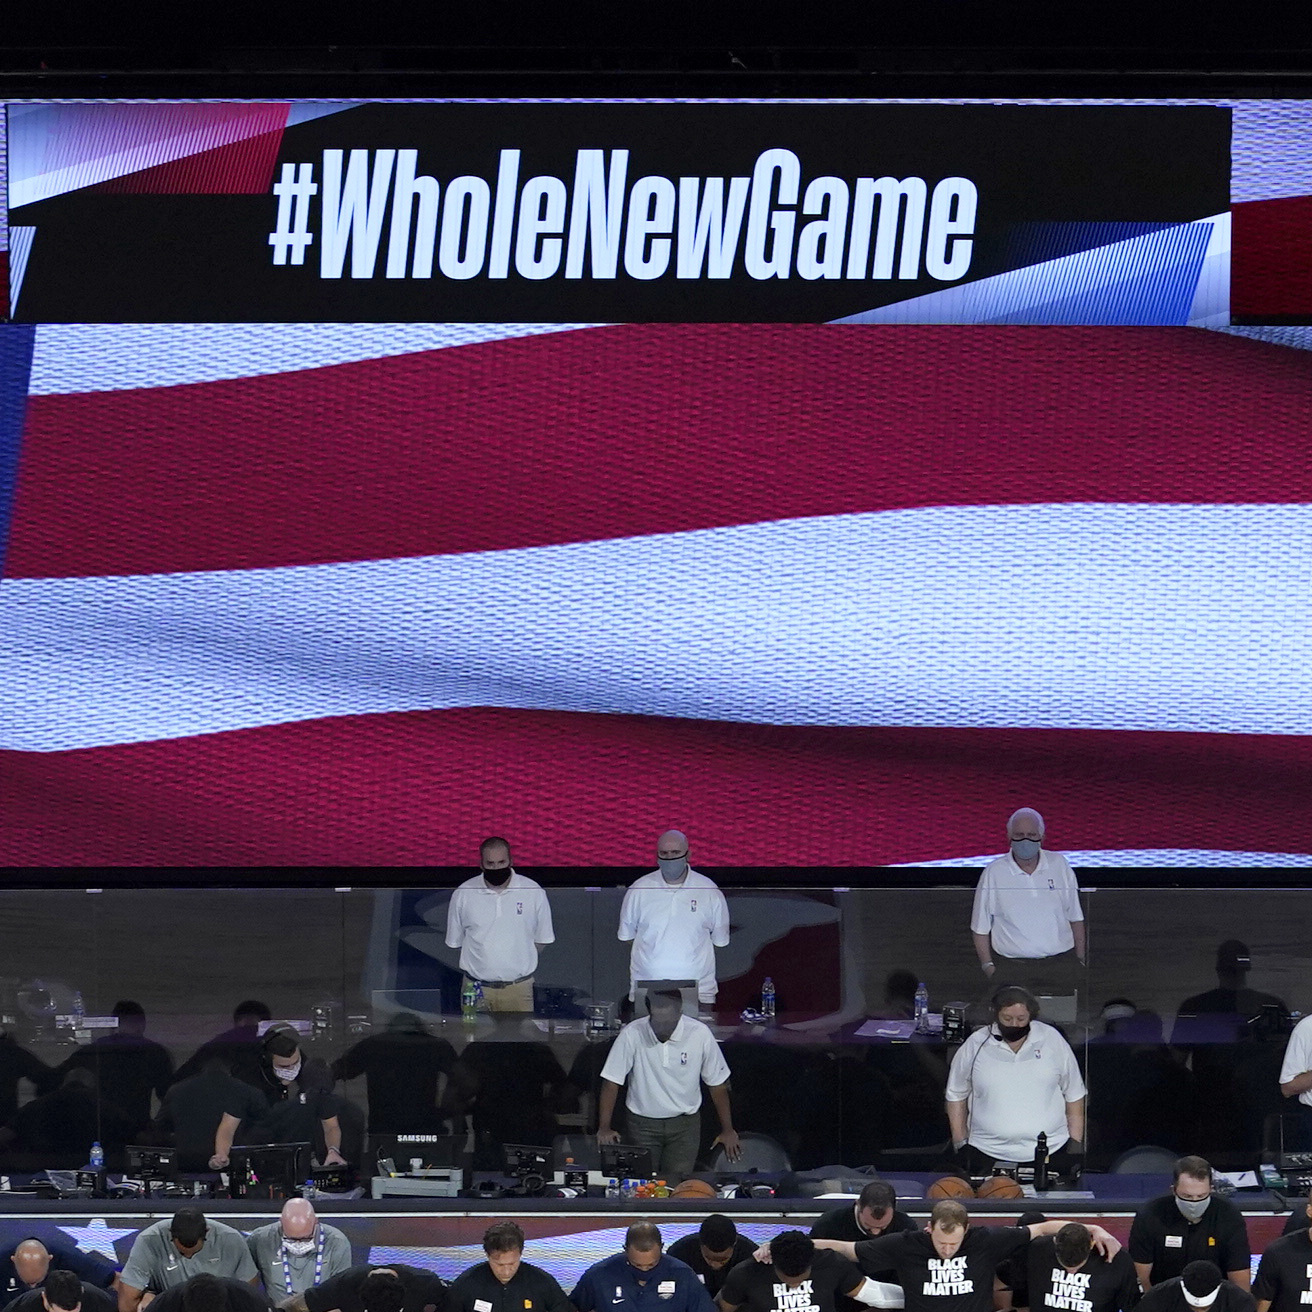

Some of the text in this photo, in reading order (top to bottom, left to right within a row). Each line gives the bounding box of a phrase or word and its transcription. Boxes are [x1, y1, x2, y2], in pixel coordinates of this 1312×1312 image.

[268, 148, 978, 280] #WholeNewGame
[397, 1134, 437, 1142] SAMSUNG
[927, 1255, 967, 1271] BLACK
[931, 1269, 964, 1283] LIVES
[1051, 1268, 1091, 1288] BLACK
[923, 1280, 973, 1296] MATTER
[1053, 1282, 1085, 1300] LIVES
[778, 1294, 810, 1309] LIVES
[1044, 1293, 1093, 1312] MATTER
